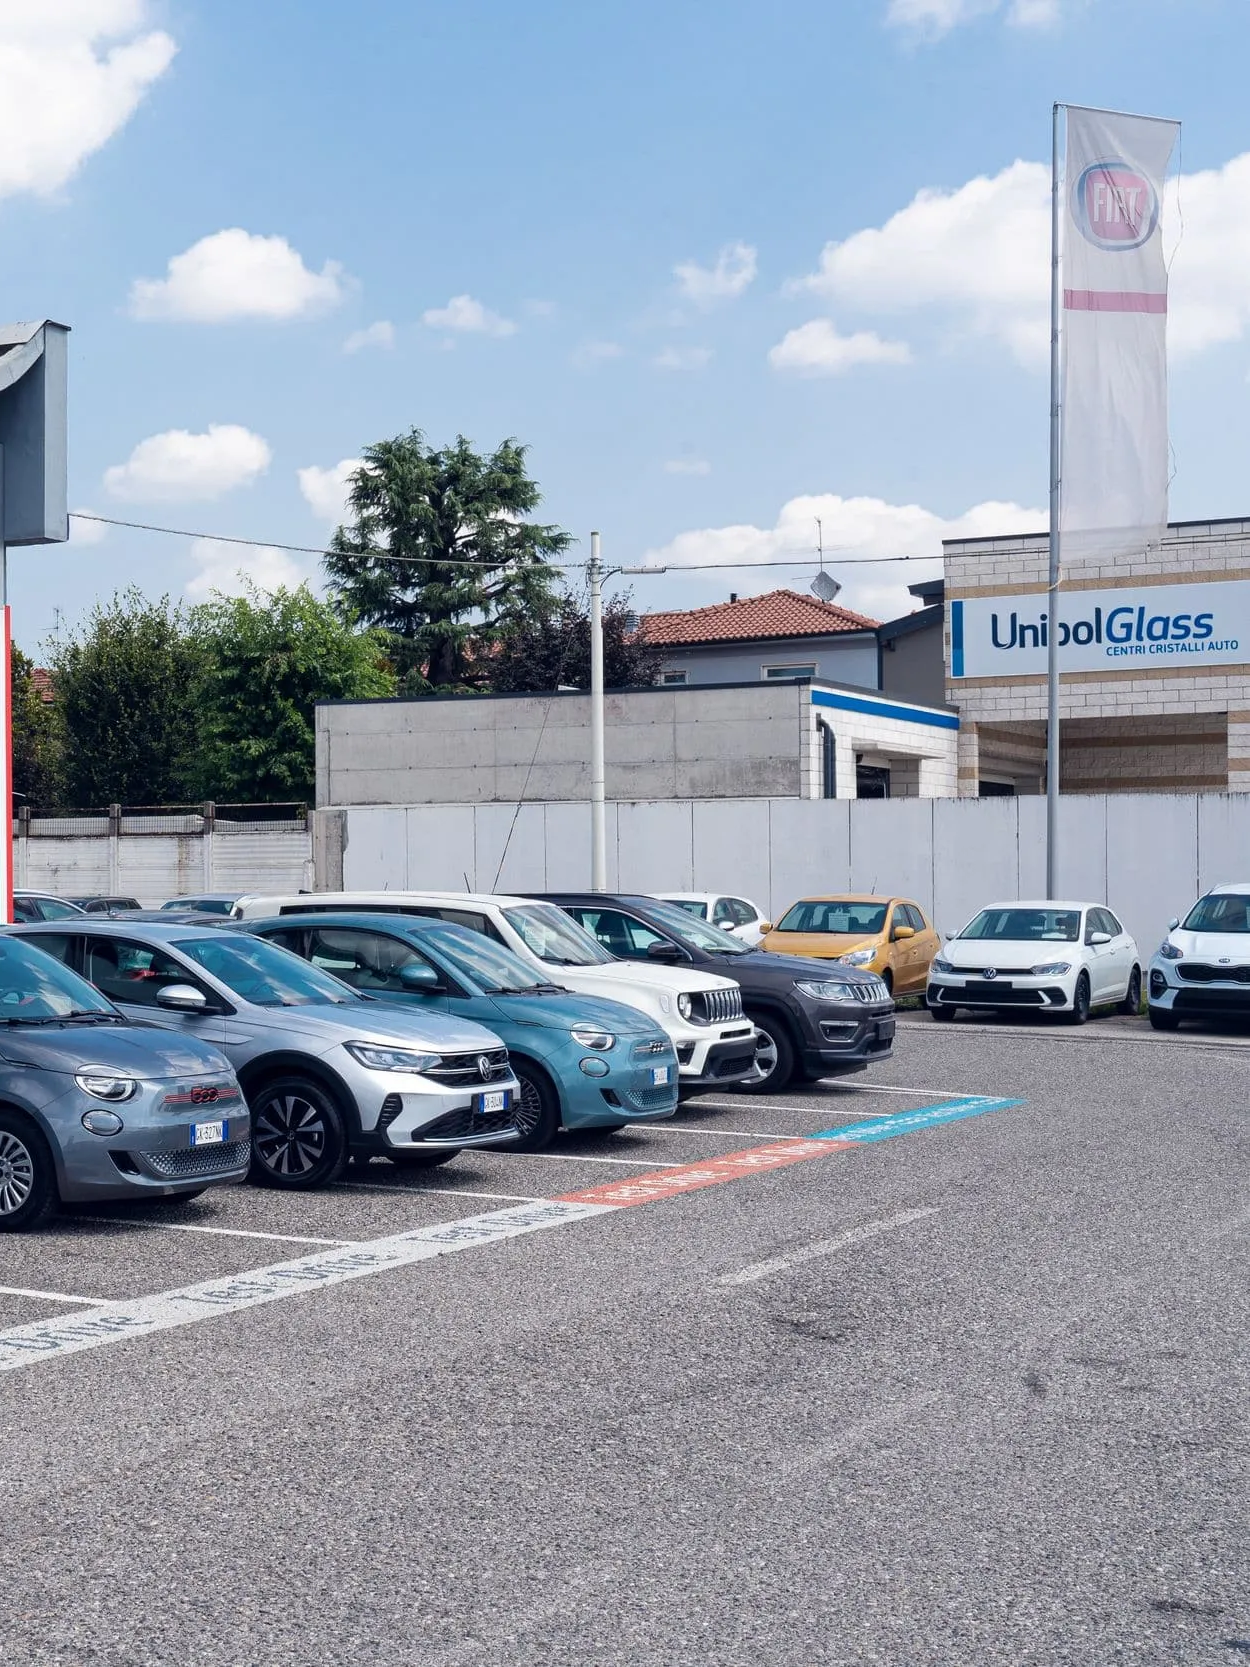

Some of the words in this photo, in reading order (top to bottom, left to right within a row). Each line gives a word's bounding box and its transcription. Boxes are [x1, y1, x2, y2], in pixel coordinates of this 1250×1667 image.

[1093, 183, 1141, 223] FIAT
[1106, 645, 1146, 657] CENTRI
[1149, 642, 1202, 654] CRISTALLI
[1208, 639, 1239, 651] AUTO
[168, 1278, 278, 1305] Test
[267, 1252, 400, 1282] Drive
